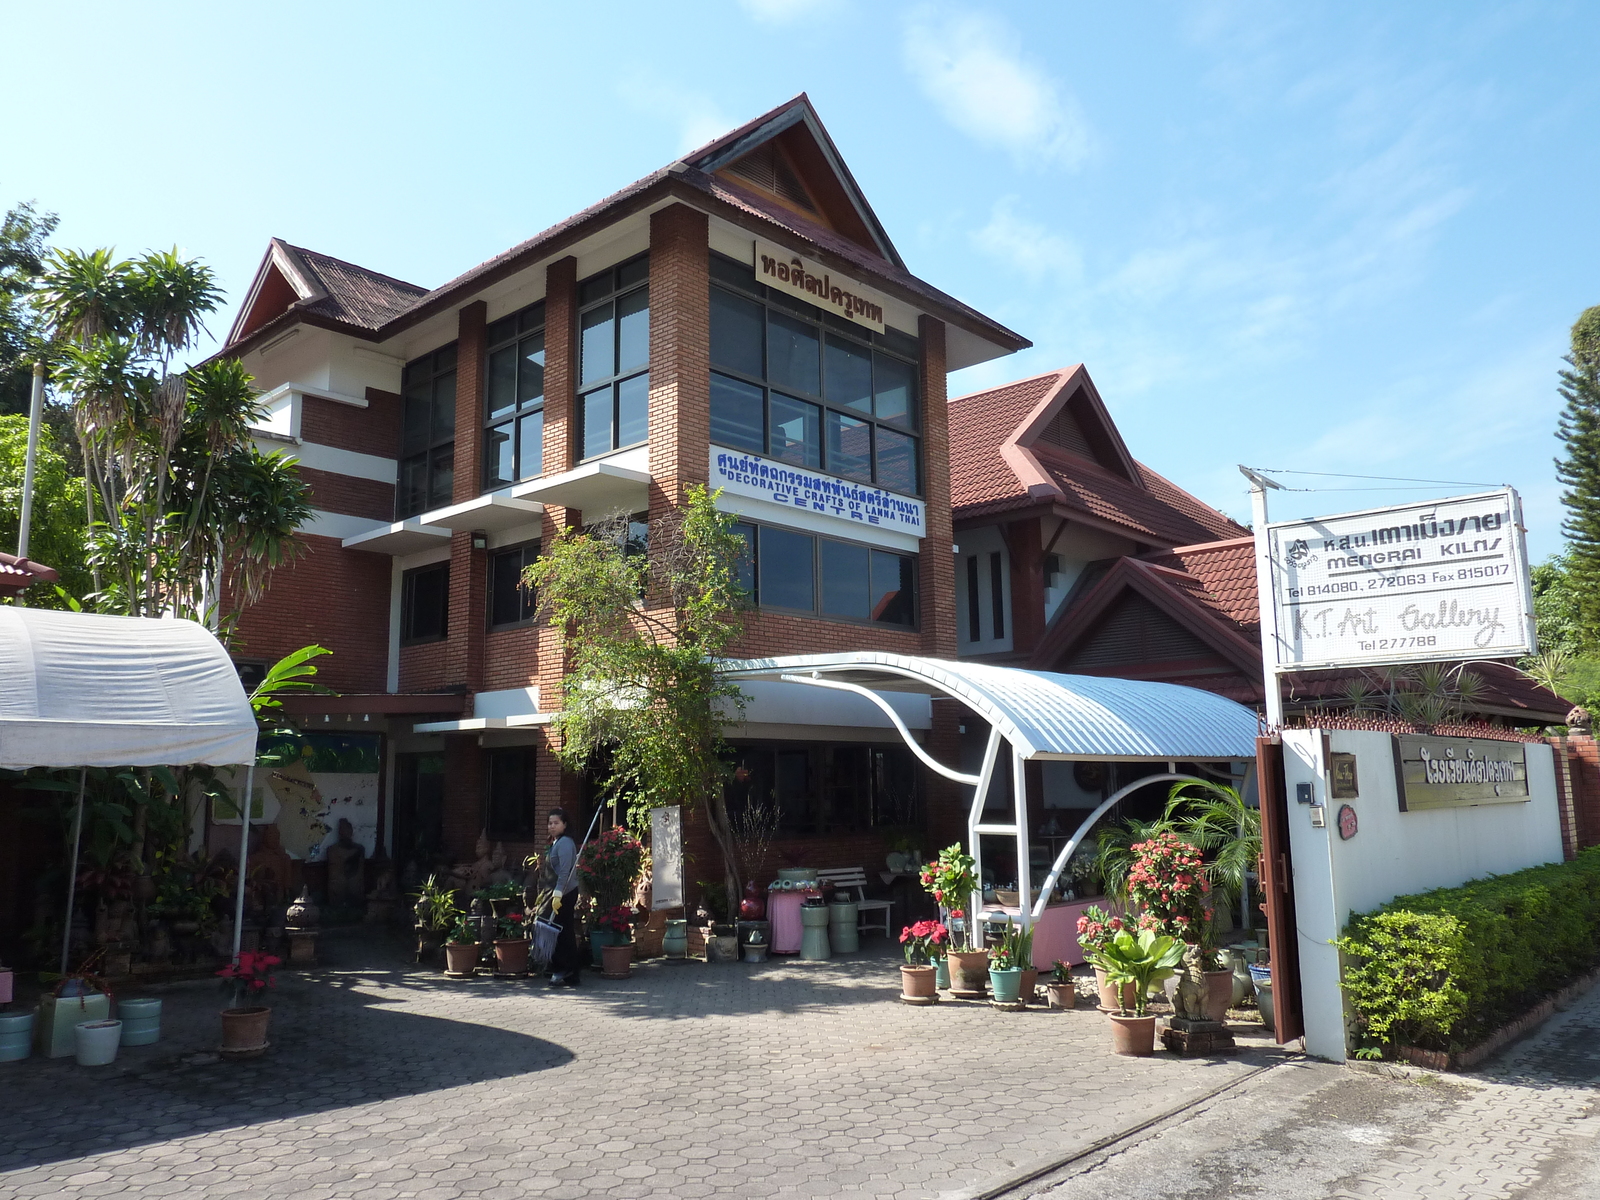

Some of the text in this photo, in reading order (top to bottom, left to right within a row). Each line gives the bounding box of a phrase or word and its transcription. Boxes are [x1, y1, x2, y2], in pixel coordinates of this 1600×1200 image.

[727, 470, 920, 526] DECORATIVE CRAFTS OF LANNA THAI
[773, 492, 880, 525] CENTRE
[1327, 547, 1422, 570] MENGRAI
[1440, 537, 1502, 557] KILNS
[1285, 587, 1304, 598] Tel
[1368, 573, 1426, 590] 272063
[1432, 571, 1455, 583] Fax
[1457, 564, 1510, 580] 815017
[1358, 635, 1437, 651] Tel 277788
